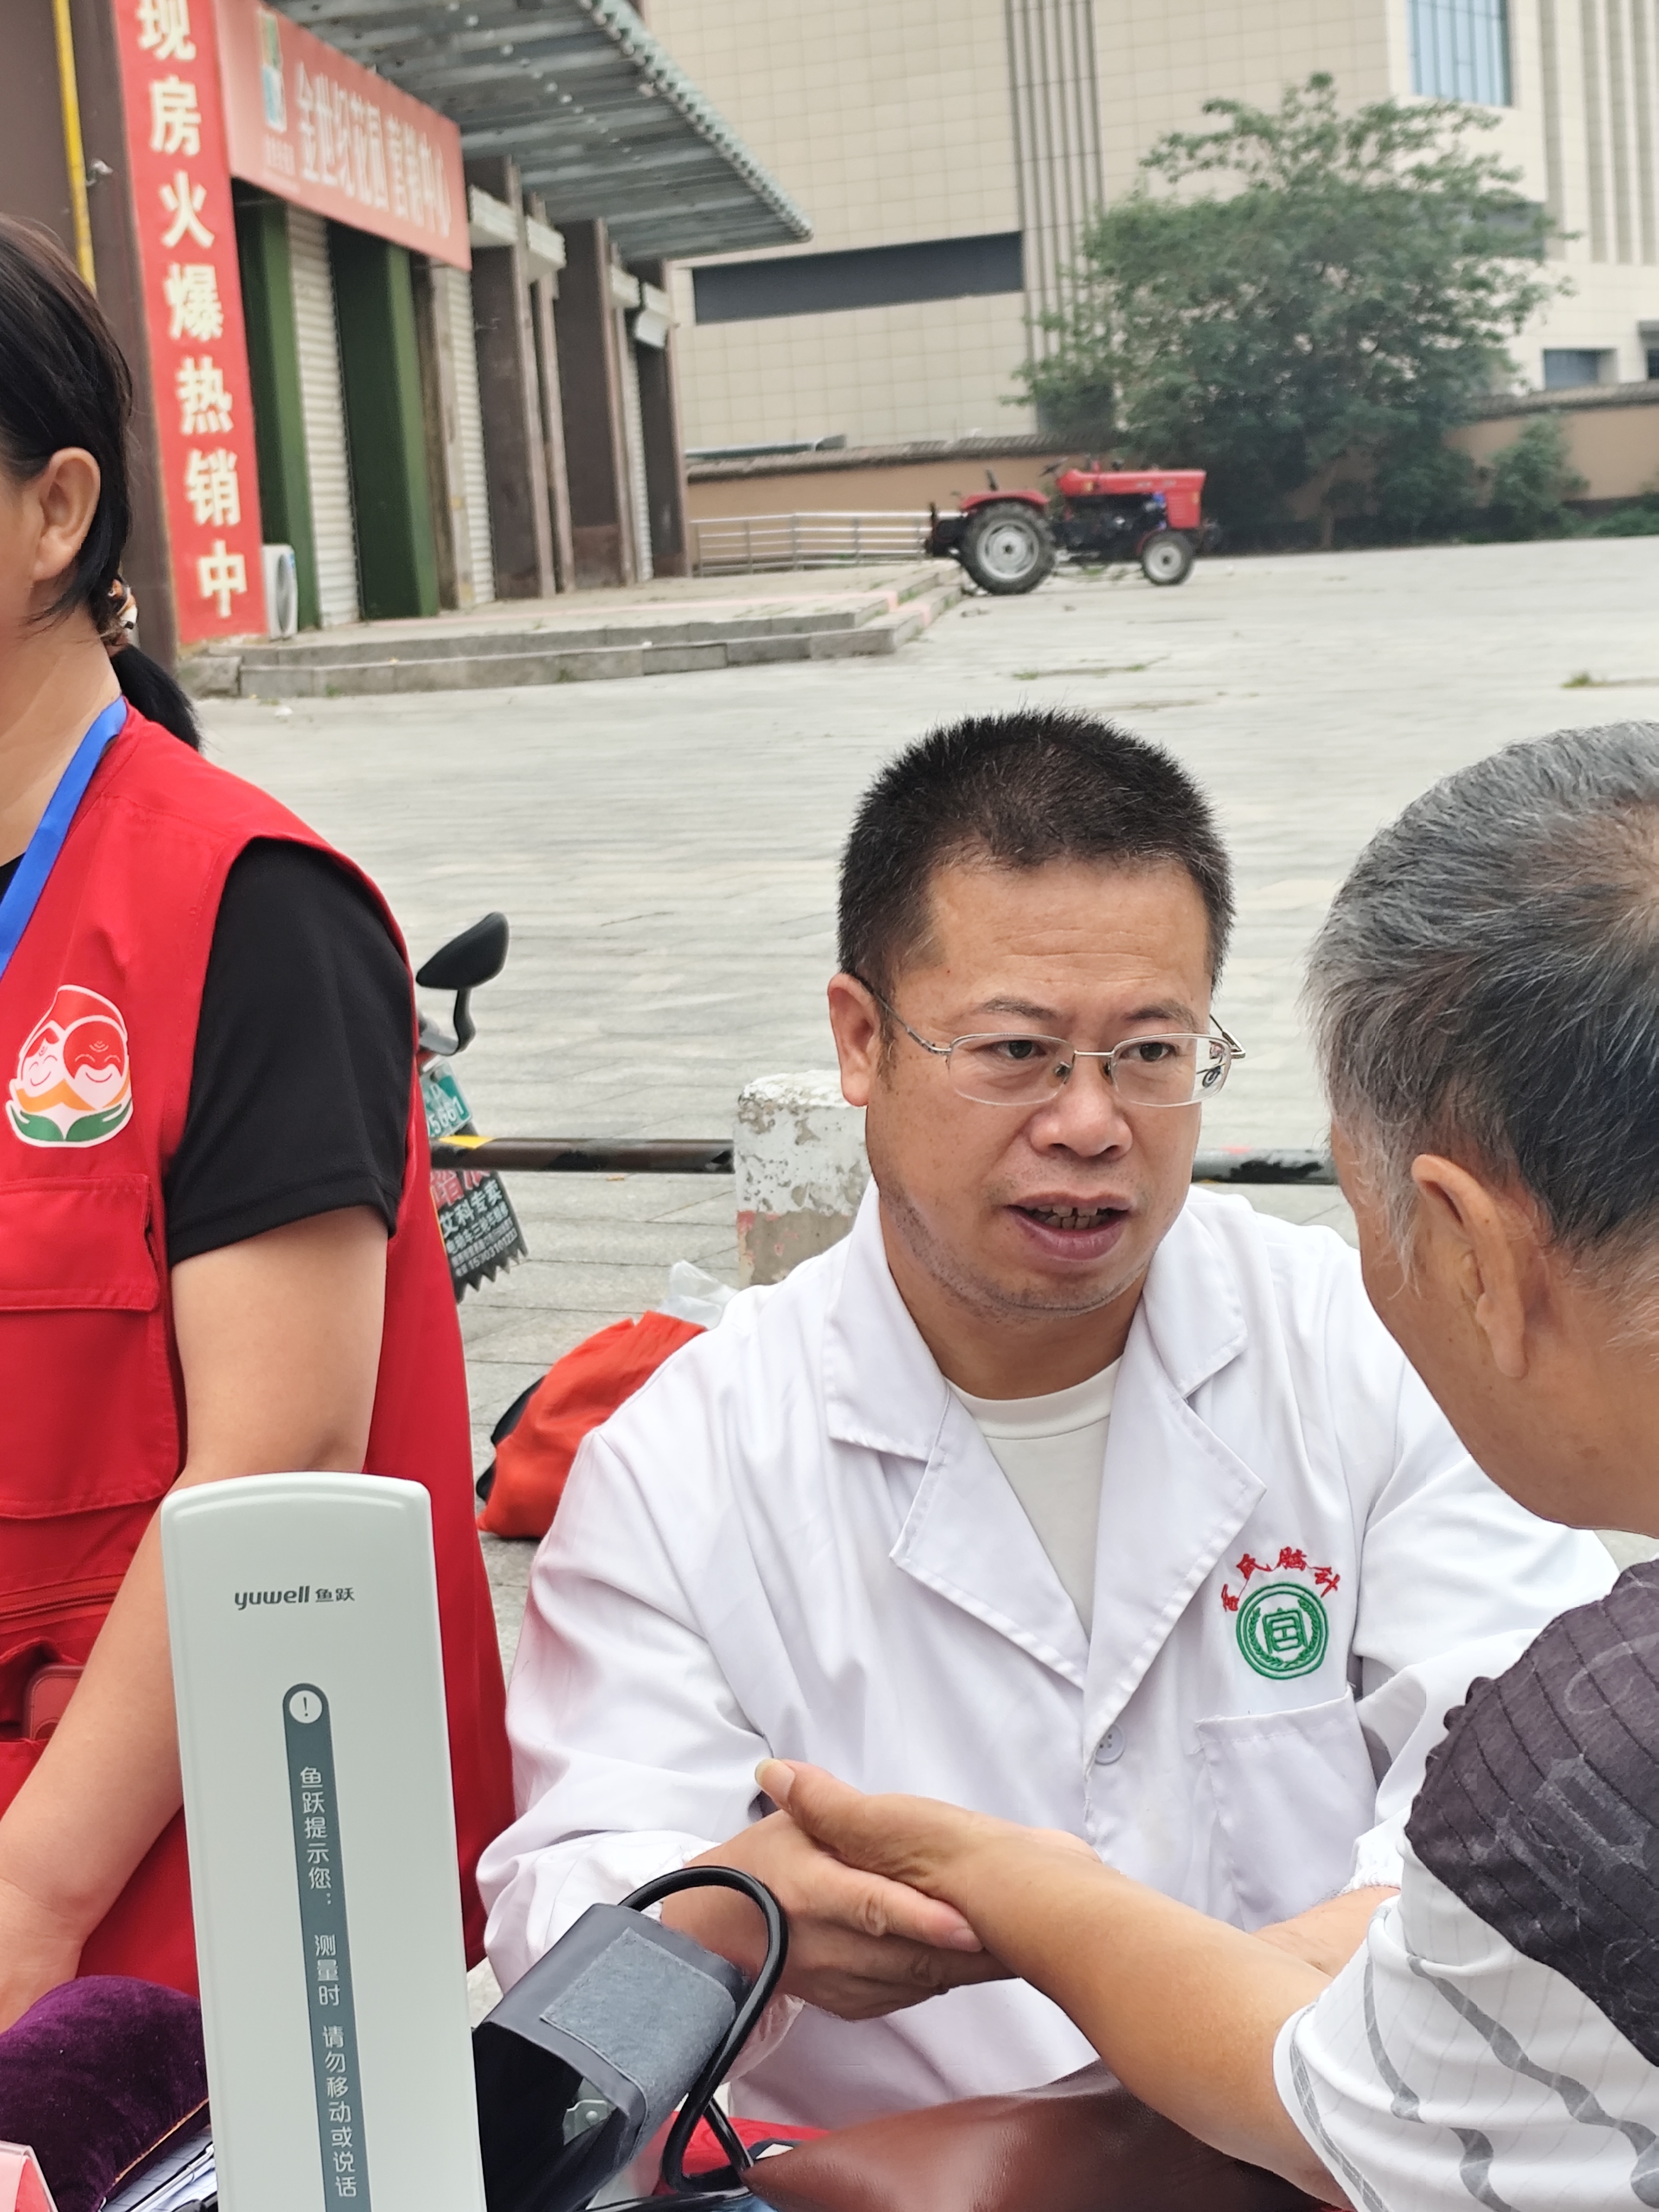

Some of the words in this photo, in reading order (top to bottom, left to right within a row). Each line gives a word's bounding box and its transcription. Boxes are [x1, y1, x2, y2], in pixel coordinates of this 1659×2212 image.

[134, 0, 248, 619] 现房火爆热销中
[428, 1096, 464, 1135] 5661
[235, 1585, 310, 1610] yuwell
[314, 1586, 355, 1603] 鱼跃
[314, 1934, 340, 2007] 测量时
[323, 2025, 358, 2198] 请勿移动或说话
